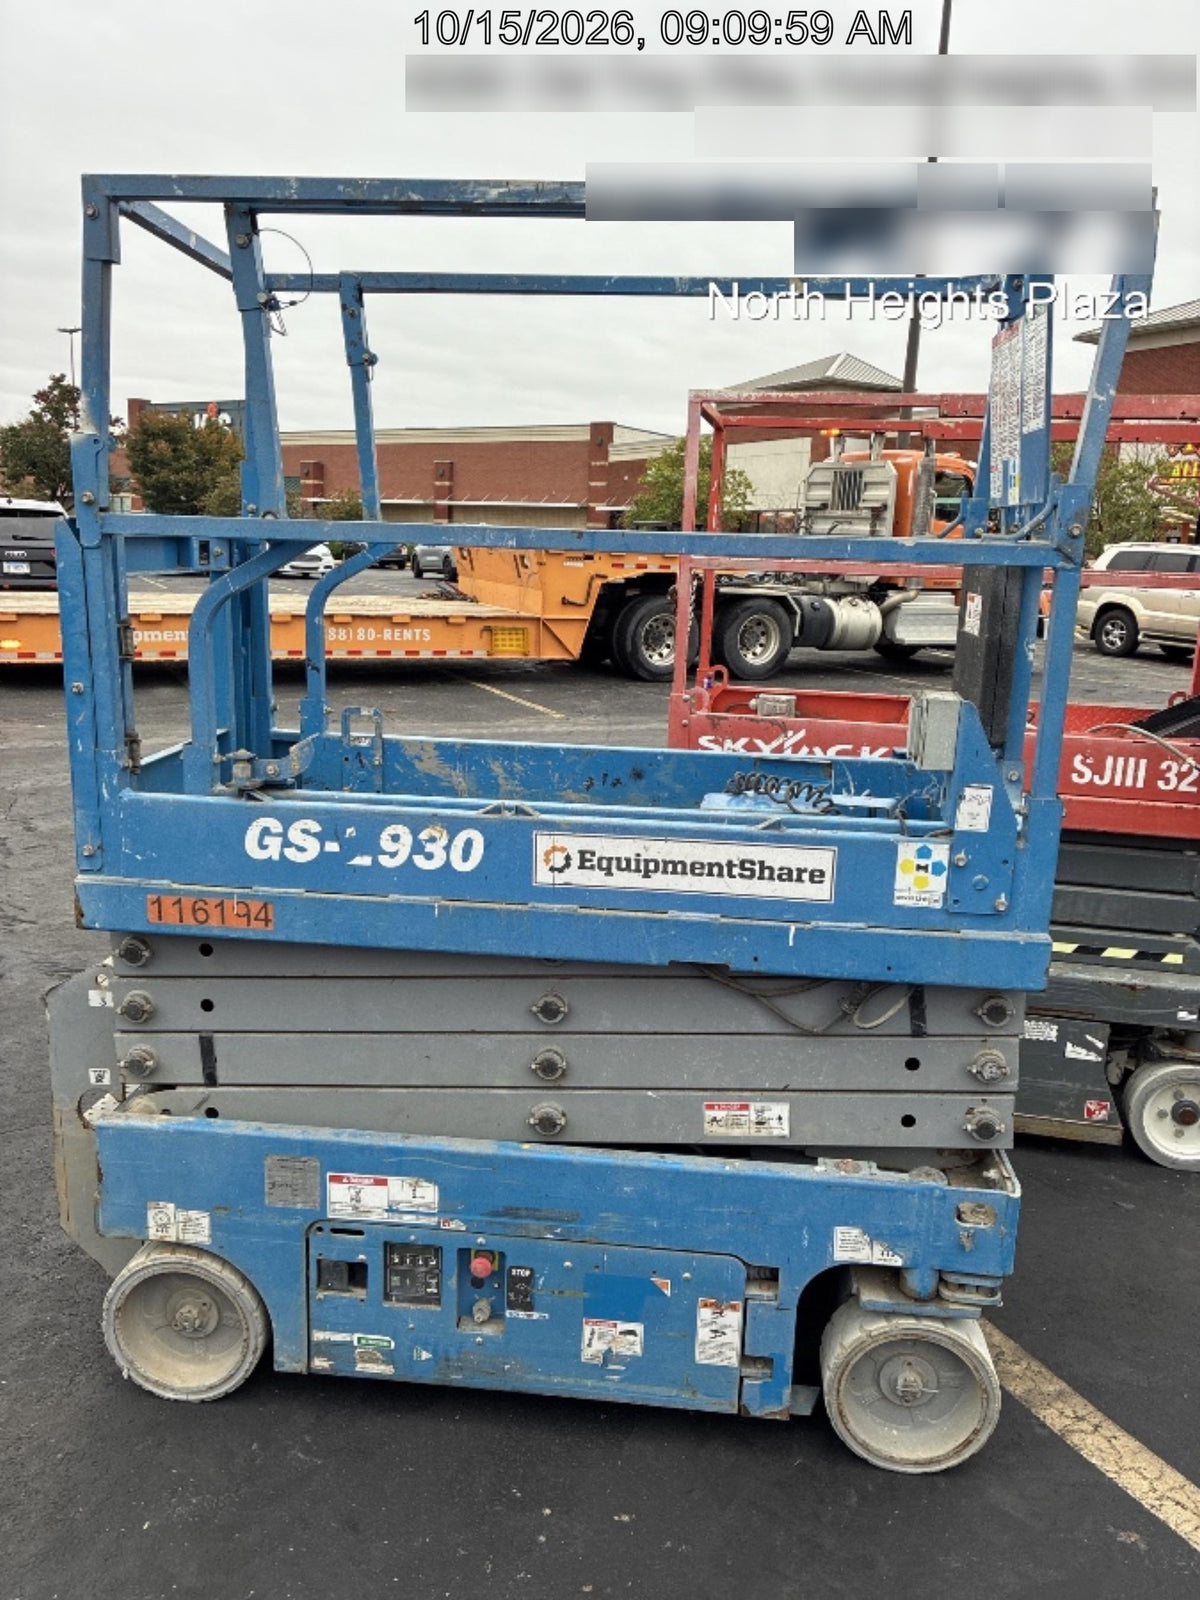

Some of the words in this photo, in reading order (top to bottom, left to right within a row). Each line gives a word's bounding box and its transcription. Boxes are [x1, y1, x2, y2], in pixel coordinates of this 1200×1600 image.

[327, 627, 353, 642] 88)
[356, 627, 432, 642] 80-RENTS
[1071, 753, 1148, 788] SJIII
[1157, 757, 1198, 793] 32
[577, 849, 827, 885] EquipmentShare
[150, 895, 273, 927] 116194
